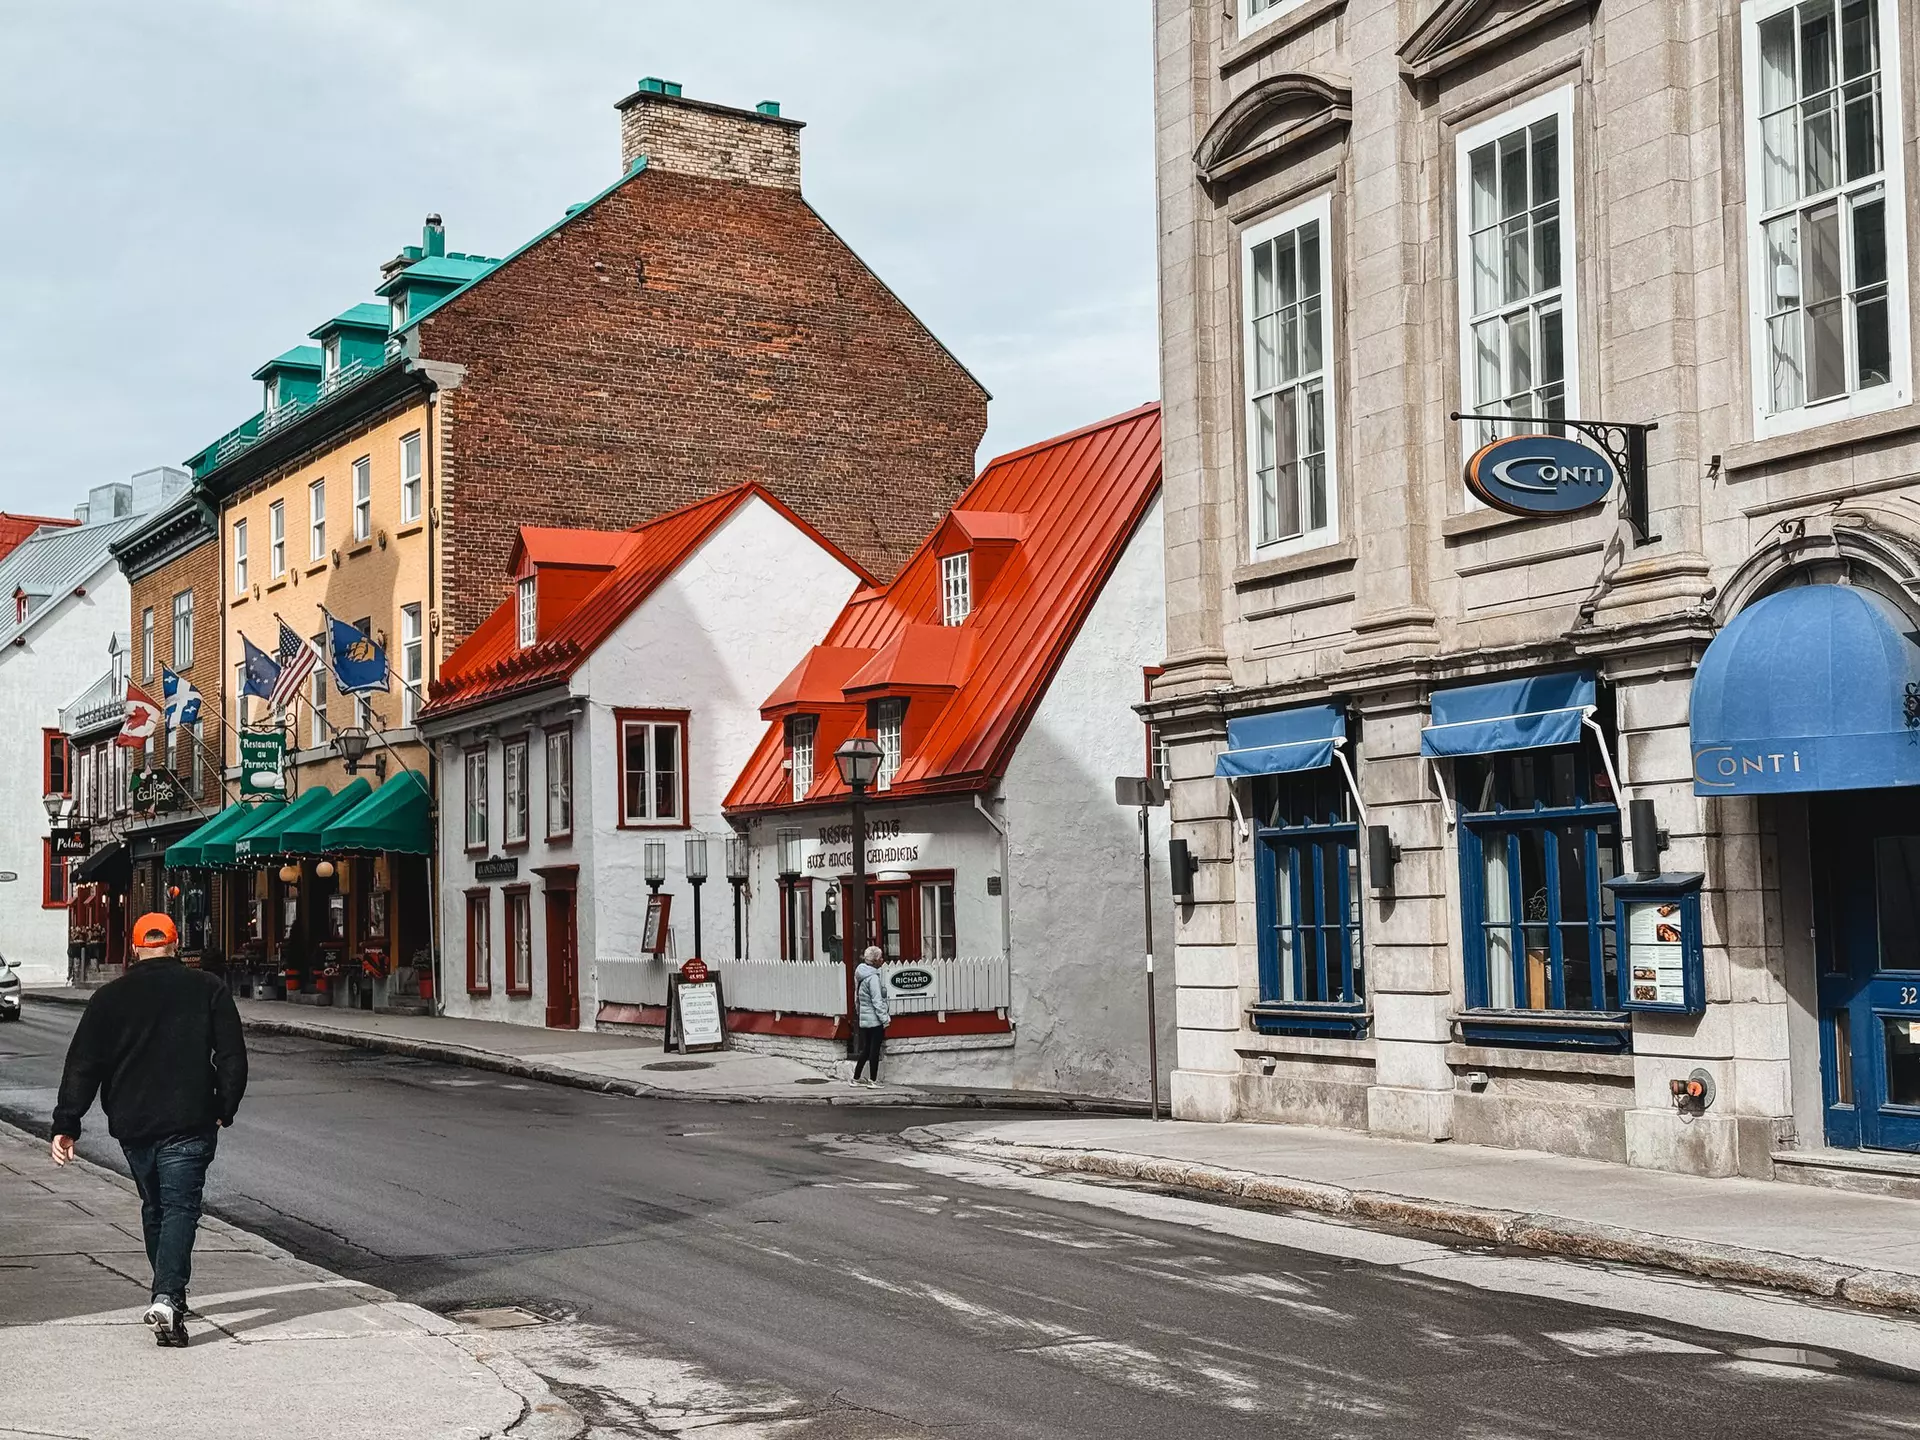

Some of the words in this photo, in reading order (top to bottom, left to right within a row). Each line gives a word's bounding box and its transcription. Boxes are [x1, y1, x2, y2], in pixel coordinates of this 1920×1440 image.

[1491, 456, 1604, 491] CONTI
[243, 738, 278, 749] Restaurant
[807, 852, 826, 869] AUX
[828, 850, 856, 868] ANCIE
[866, 845, 919, 864] CANADIENS
[895, 976, 928, 984] RICHARD
[1900, 986, 1918, 1005] 32
